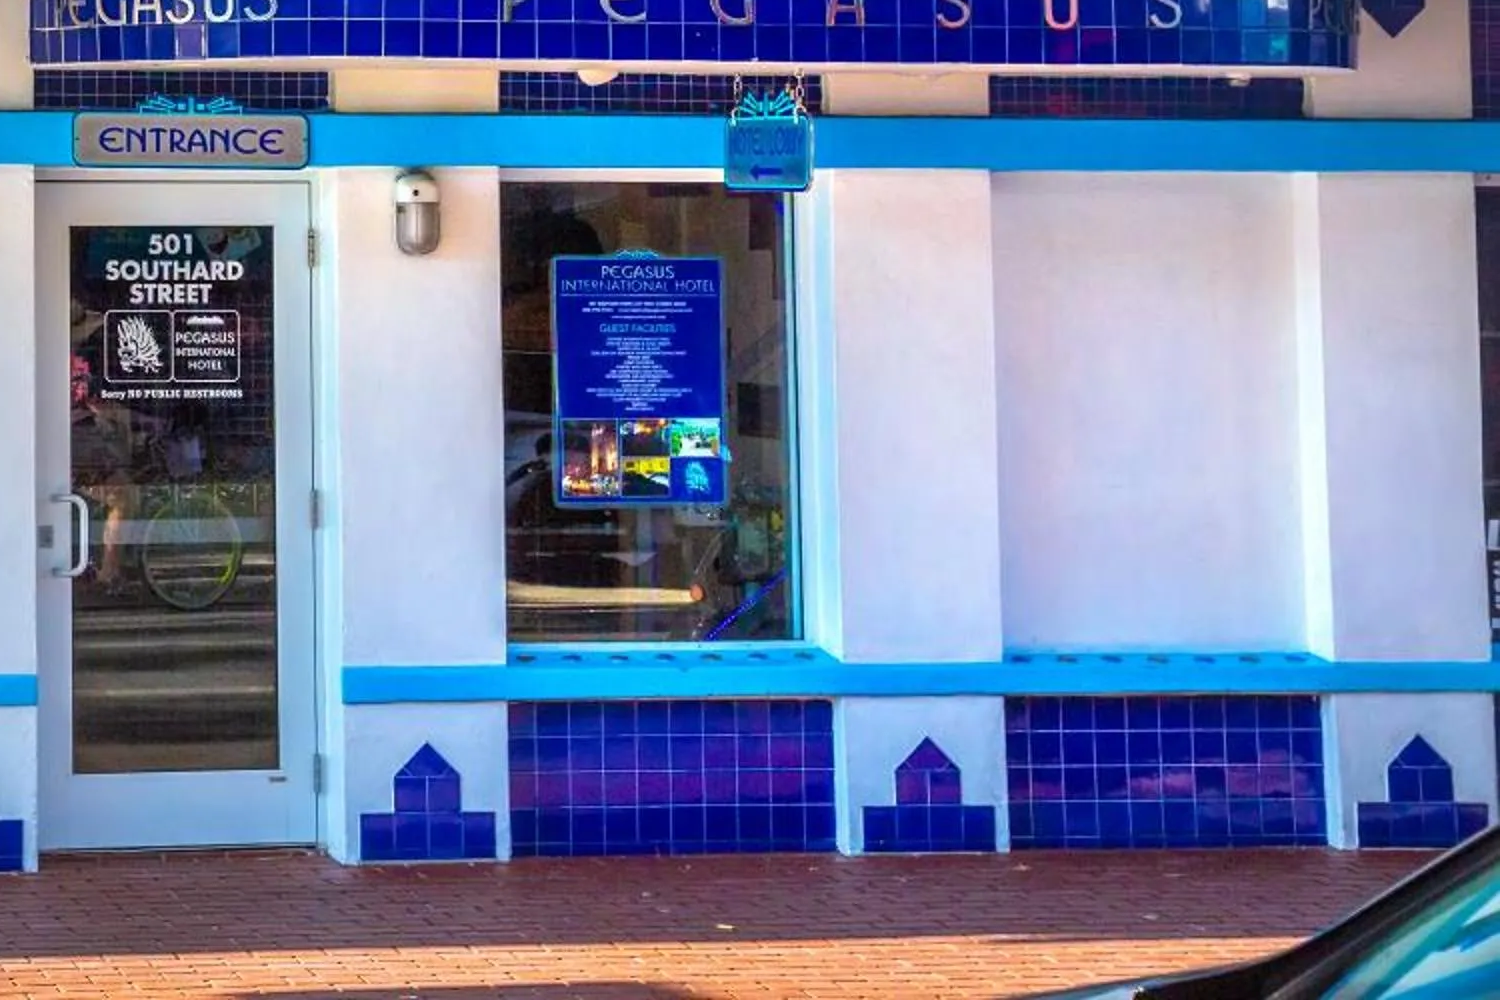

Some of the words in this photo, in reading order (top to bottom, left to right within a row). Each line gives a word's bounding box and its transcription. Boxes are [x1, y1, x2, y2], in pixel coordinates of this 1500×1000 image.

[99, 126, 285, 155] ENTRANCE
[148, 233, 193, 255] 501
[105, 260, 245, 281] SOUTHARD
[601, 265, 675, 279] PEGASUS
[561, 280, 668, 293] INTERNATIONAL
[675, 280, 715, 293] HOTEL
[129, 283, 213, 304] STREET
[599, 323, 630, 333] GUEST
[175, 332, 236, 344] PEGASUS
[175, 348, 237, 357] INTERNATIONAL
[187, 360, 223, 370] HOTEL
[101, 389, 126, 400] Sorry
[127, 389, 143, 398] NO
[144, 389, 182, 398] PUBLIC
[183, 388, 243, 398] RESTROOMS
